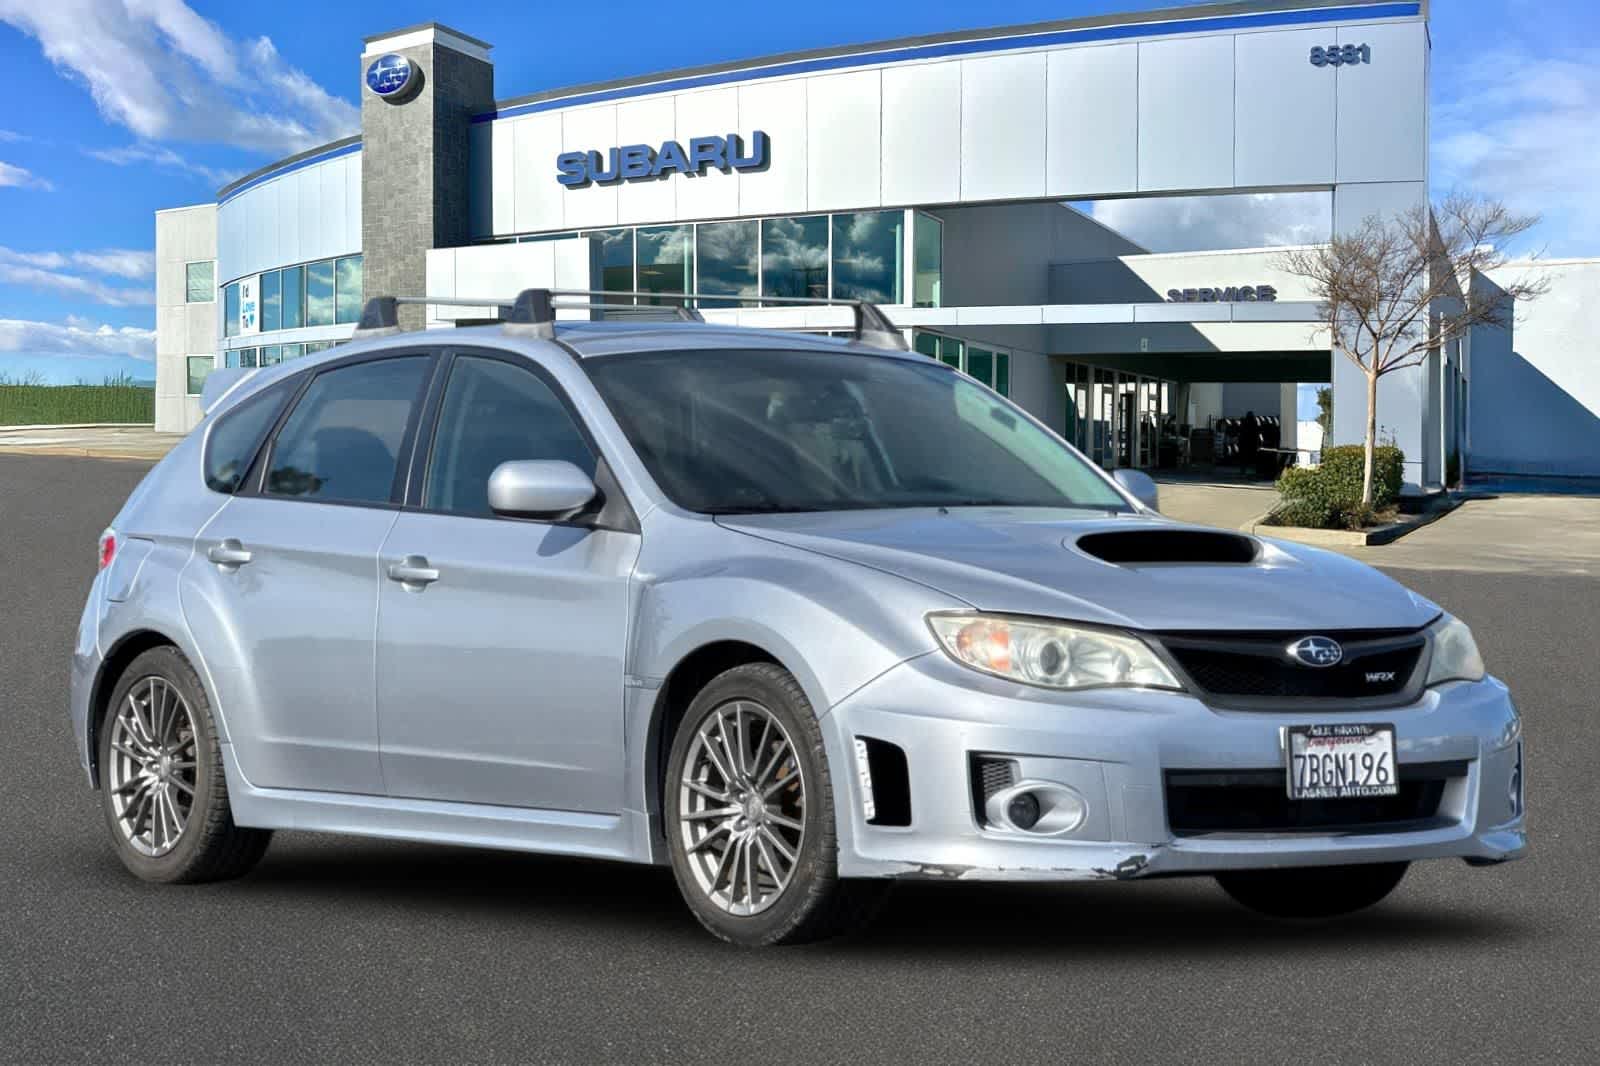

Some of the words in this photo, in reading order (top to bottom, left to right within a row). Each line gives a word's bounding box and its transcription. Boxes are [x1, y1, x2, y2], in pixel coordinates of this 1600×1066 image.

[557, 130, 770, 190] SUBARU
[1167, 285, 1277, 303] SERVICE
[1365, 671, 1396, 682] WRX
[1294, 752, 1389, 787] 7BGN196
